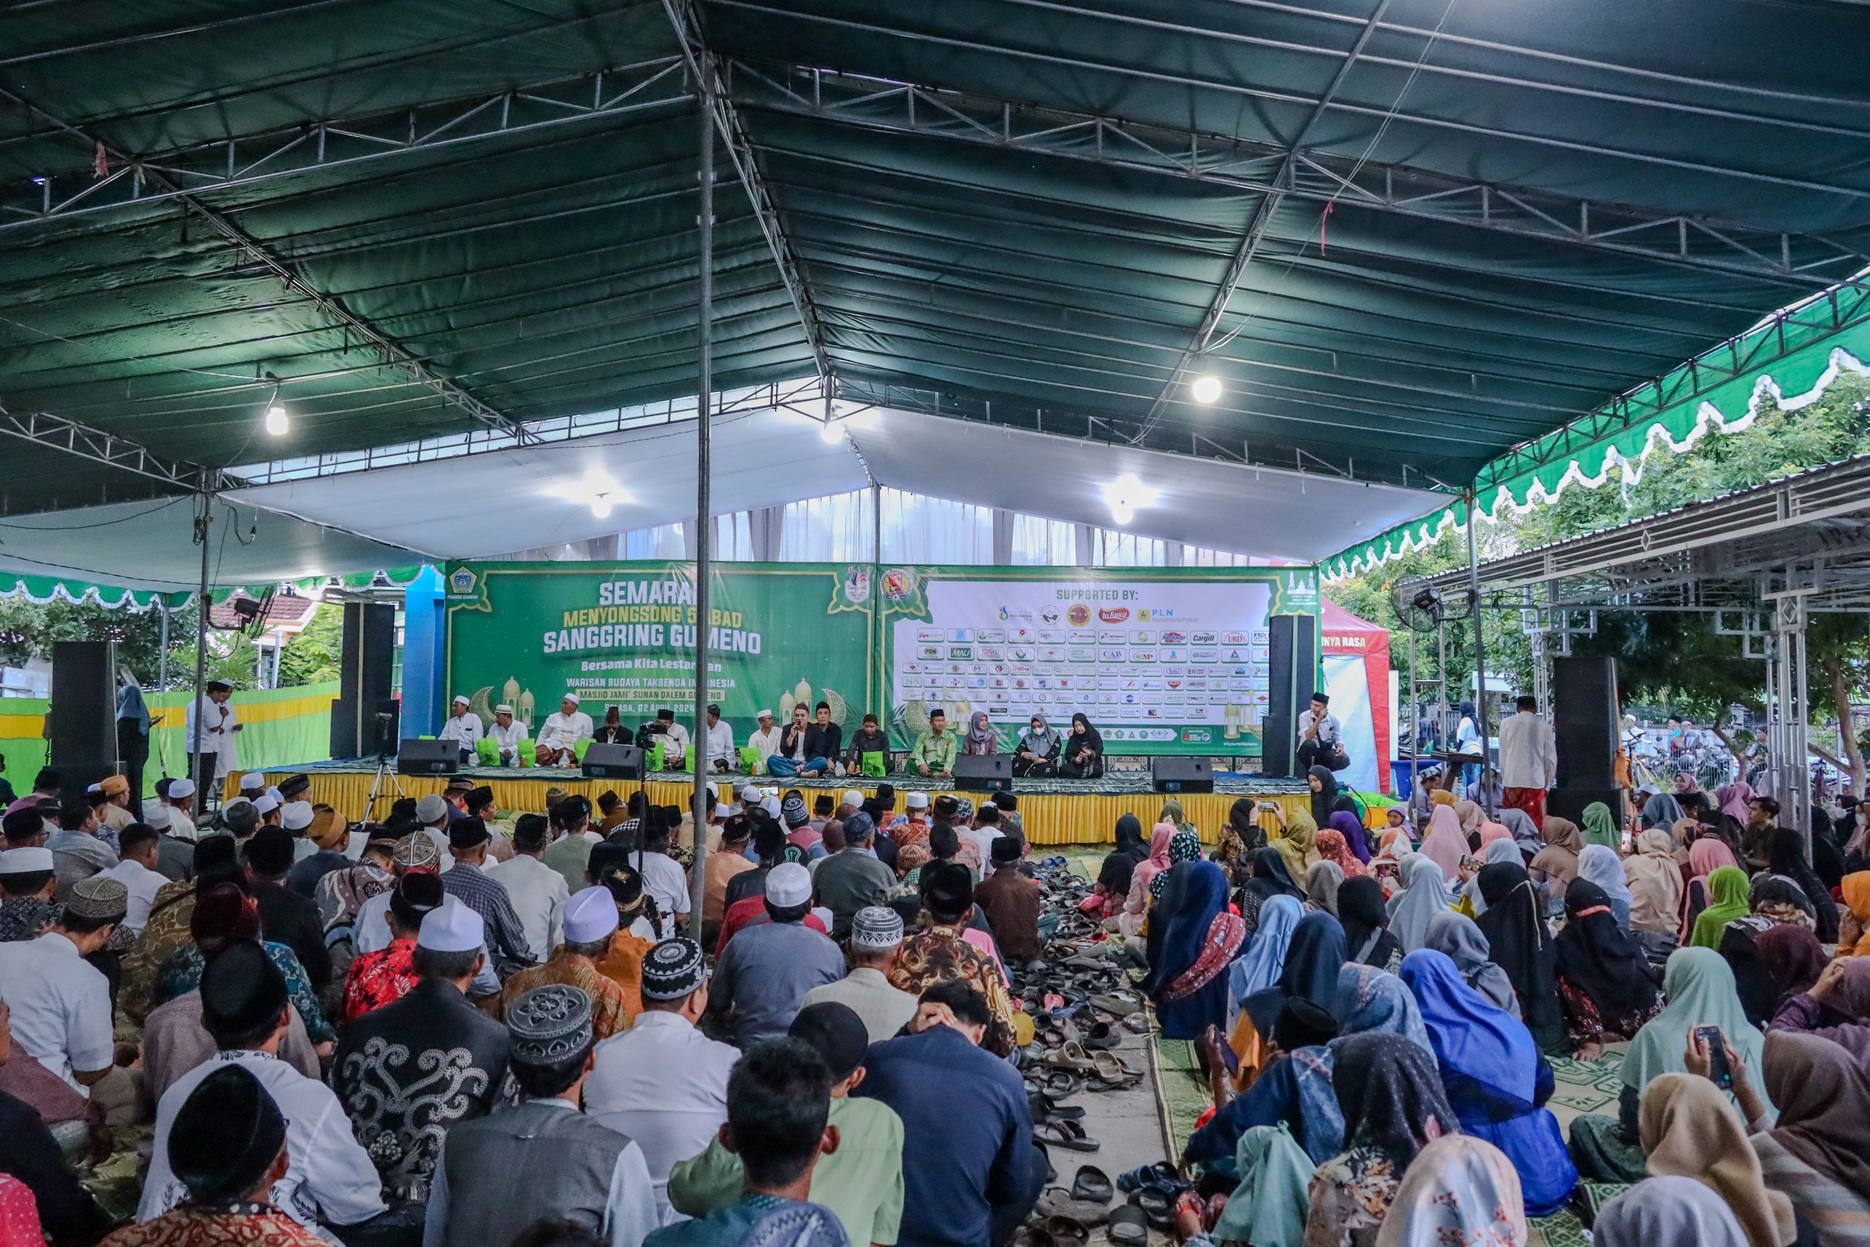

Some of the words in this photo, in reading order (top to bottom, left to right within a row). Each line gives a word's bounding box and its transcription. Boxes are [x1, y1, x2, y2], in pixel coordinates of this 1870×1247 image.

[600, 580, 697, 606] SEMARA
[1056, 589, 1119, 600] SUPPORTED
[1122, 589, 1139, 601] BY:
[564, 606, 682, 628] MENYONGSONG
[687, 606, 697, 623] 5
[708, 608, 743, 629] BAD
[1152, 609, 1174, 617] PLN
[543, 624, 664, 654] SANGGRING
[1193, 634, 1215, 643] Cargill
[1342, 637, 1367, 648] RASA
[1103, 650, 1122, 658] CAB
[581, 660, 633, 671] Bersama
[634, 657, 658, 669] Kita
[660, 658, 722, 673] Lestaran
[566, 677, 606, 688] WARISAN
[608, 677, 641, 687] BUDAYA
[642, 677, 686, 688] TAKBENDA
[688, 678, 736, 689] INNESIA
[580, 690, 608, 699] MASJID
[633, 690, 659, 699] SUNAN
[660, 690, 686, 699] DALEM
[688, 690, 721, 700] GENO
[604, 703, 636, 713] SASA,
[638, 703, 649, 713] 02
[673, 703, 696, 713] 2024
